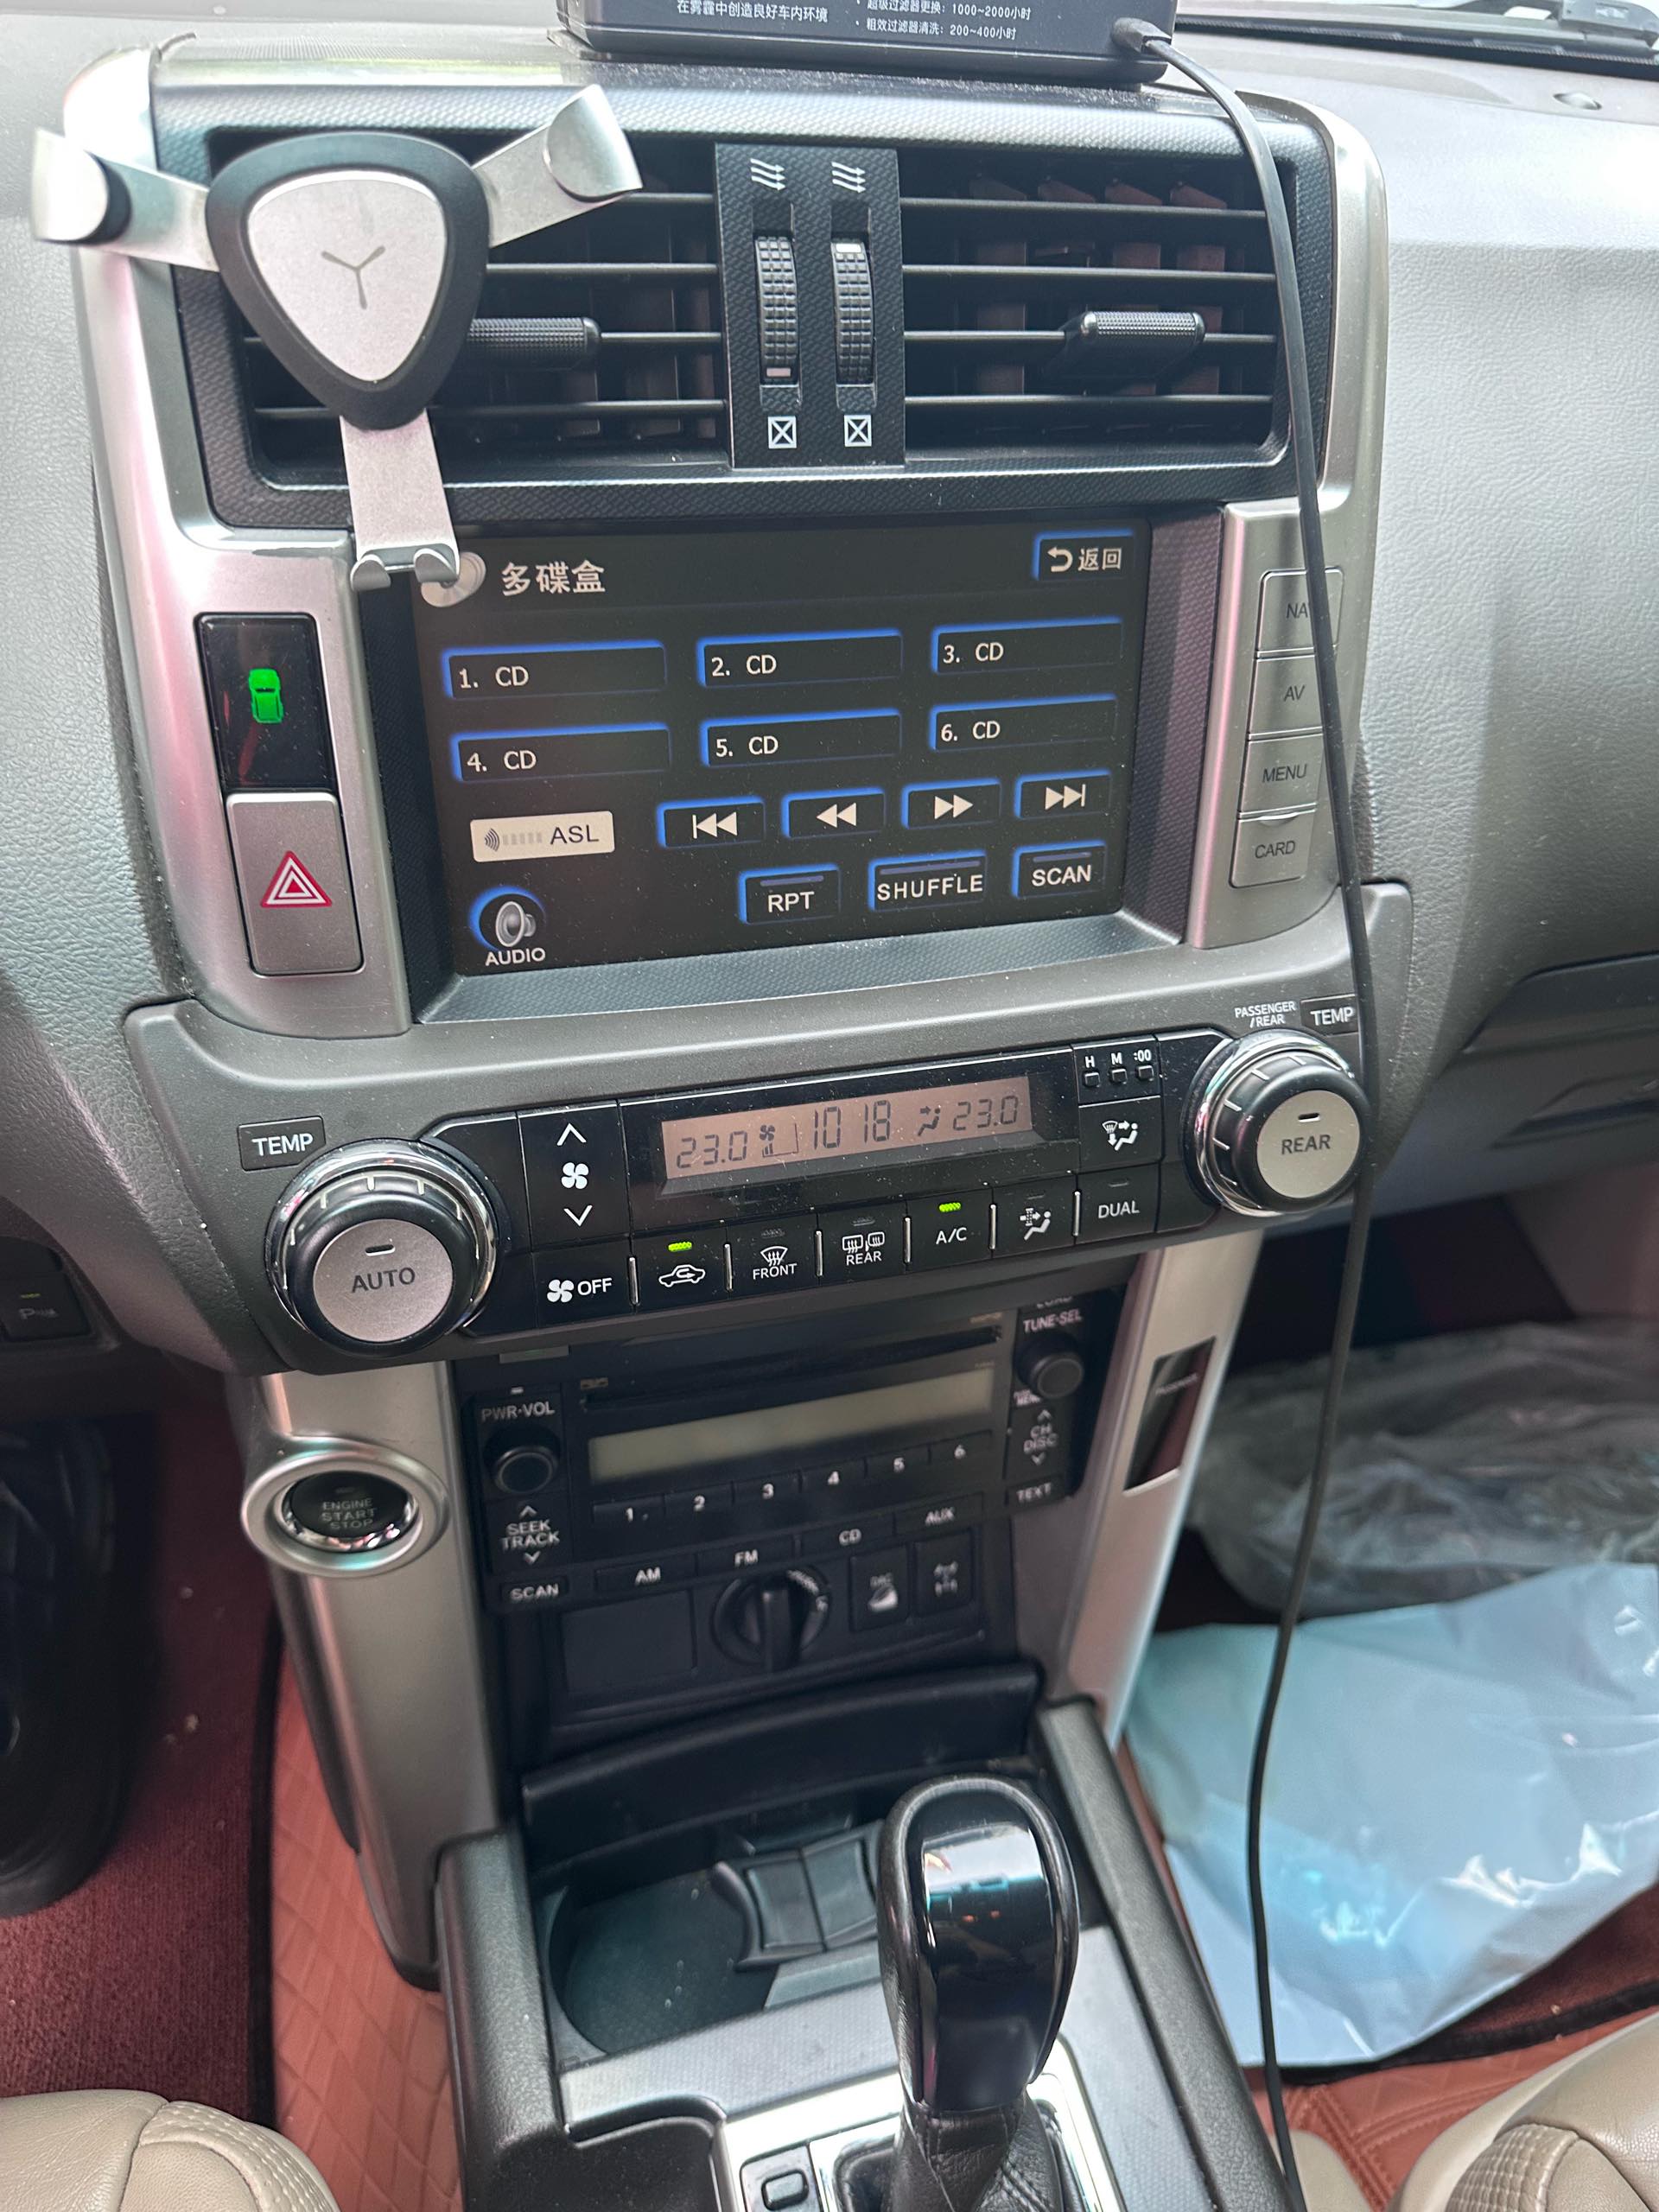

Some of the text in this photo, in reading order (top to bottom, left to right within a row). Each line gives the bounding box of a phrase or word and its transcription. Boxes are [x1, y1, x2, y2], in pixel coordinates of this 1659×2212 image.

[1077, 547, 1122, 571] 返回
[501, 559, 606, 596] 多碟盒
[1286, 601, 1312, 620] NA
[943, 642, 1005, 664] 3. CD
[711, 654, 778, 677] 2. CD
[459, 665, 529, 689] 1. CD
[1283, 685, 1306, 702] AV
[940, 721, 1001, 742] 6. CD
[715, 735, 779, 757] 5. CD
[467, 750, 537, 772] 4. CD
[1262, 764, 1307, 784] MENU
[550, 824, 600, 846] ASL
[1255, 839, 1296, 859] CARD
[1032, 864, 1093, 887] SCAN
[877, 874, 984, 902] SHUFFLE
[767, 891, 816, 913] RPT
[485, 947, 546, 967] AUDIO
[1234, 1001, 1297, 1019] PASSENGER
[1310, 1006, 1355, 1027] TEMP
[1084, 1055, 1096, 1069] H
[1110, 1052, 1123, 1065] M
[952, 1095, 1020, 1132] 23.0
[251, 1133, 314, 1157] TEMP
[676, 1130, 748, 1170] 23.0
[1281, 1134, 1332, 1155] REAR
[1097, 1199, 1141, 1219] DUAL
[935, 1227, 968, 1245] A/C
[846, 1249, 882, 1266] REAR
[351, 1267, 416, 1294] AUTO
[753, 1262, 798, 1280] FRONT
[576, 1277, 613, 1297] OFF
[827, 1471, 841, 1486] 4
[762, 1482, 775, 1500] 3
[1016, 1481, 1052, 1503] TEXT
[321, 1497, 374, 1511] ENGINE
[694, 1495, 706, 1512] 2
[320, 1508, 378, 1522] START
[329, 1518, 374, 1530] STOP
[505, 1518, 551, 1535] SEEK
[501, 1529, 561, 1550] TRACK
[838, 1528, 862, 1547] CD
[734, 1548, 759, 1567] FM
[634, 1566, 662, 1586] AM
[510, 1583, 560, 1604] SCAN
